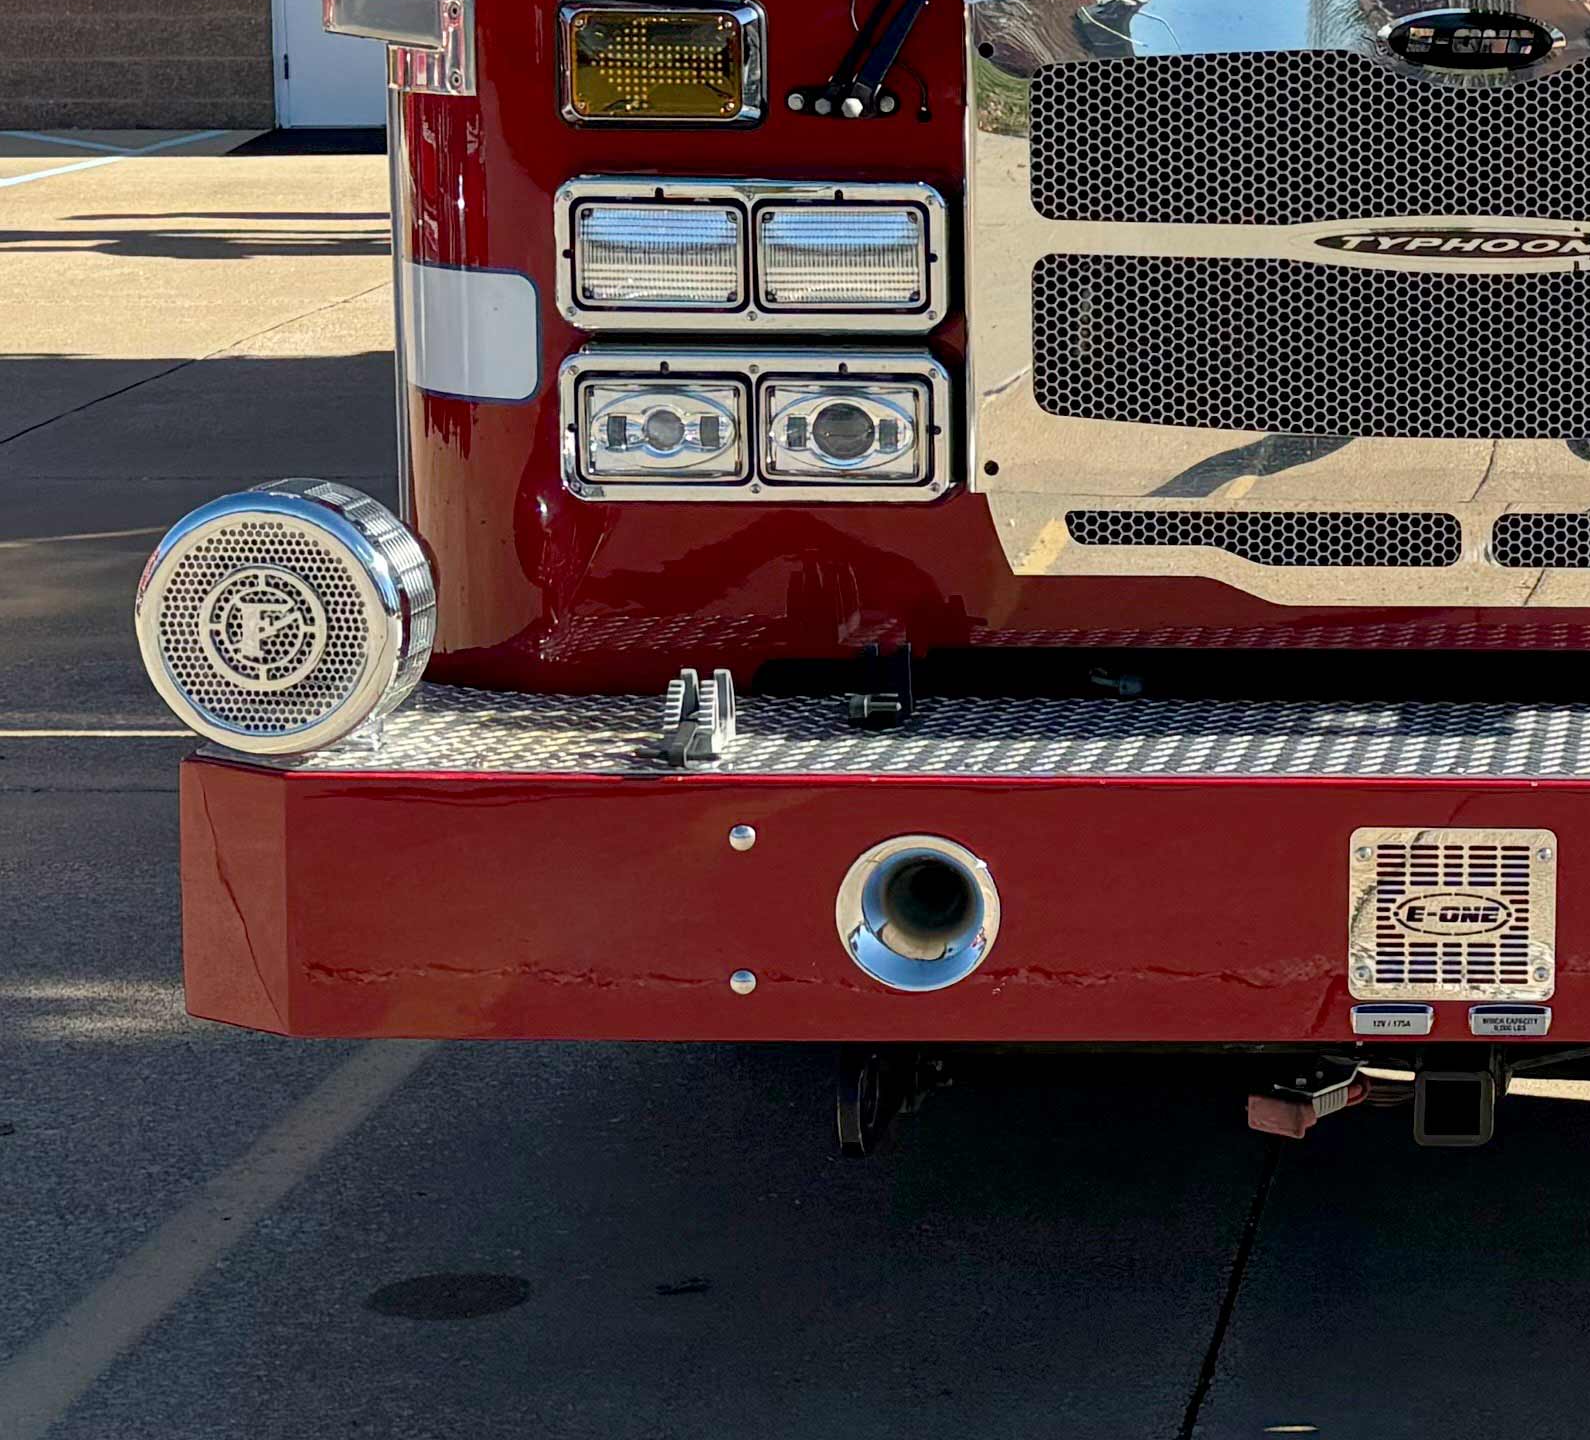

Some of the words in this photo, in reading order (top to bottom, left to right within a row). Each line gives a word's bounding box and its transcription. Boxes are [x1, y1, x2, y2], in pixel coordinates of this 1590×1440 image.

[1405, 26, 1535, 54] E-ONE
[1406, 905, 1500, 924] E-ONE
[1506, 1017, 1538, 1025] CAPACITY
